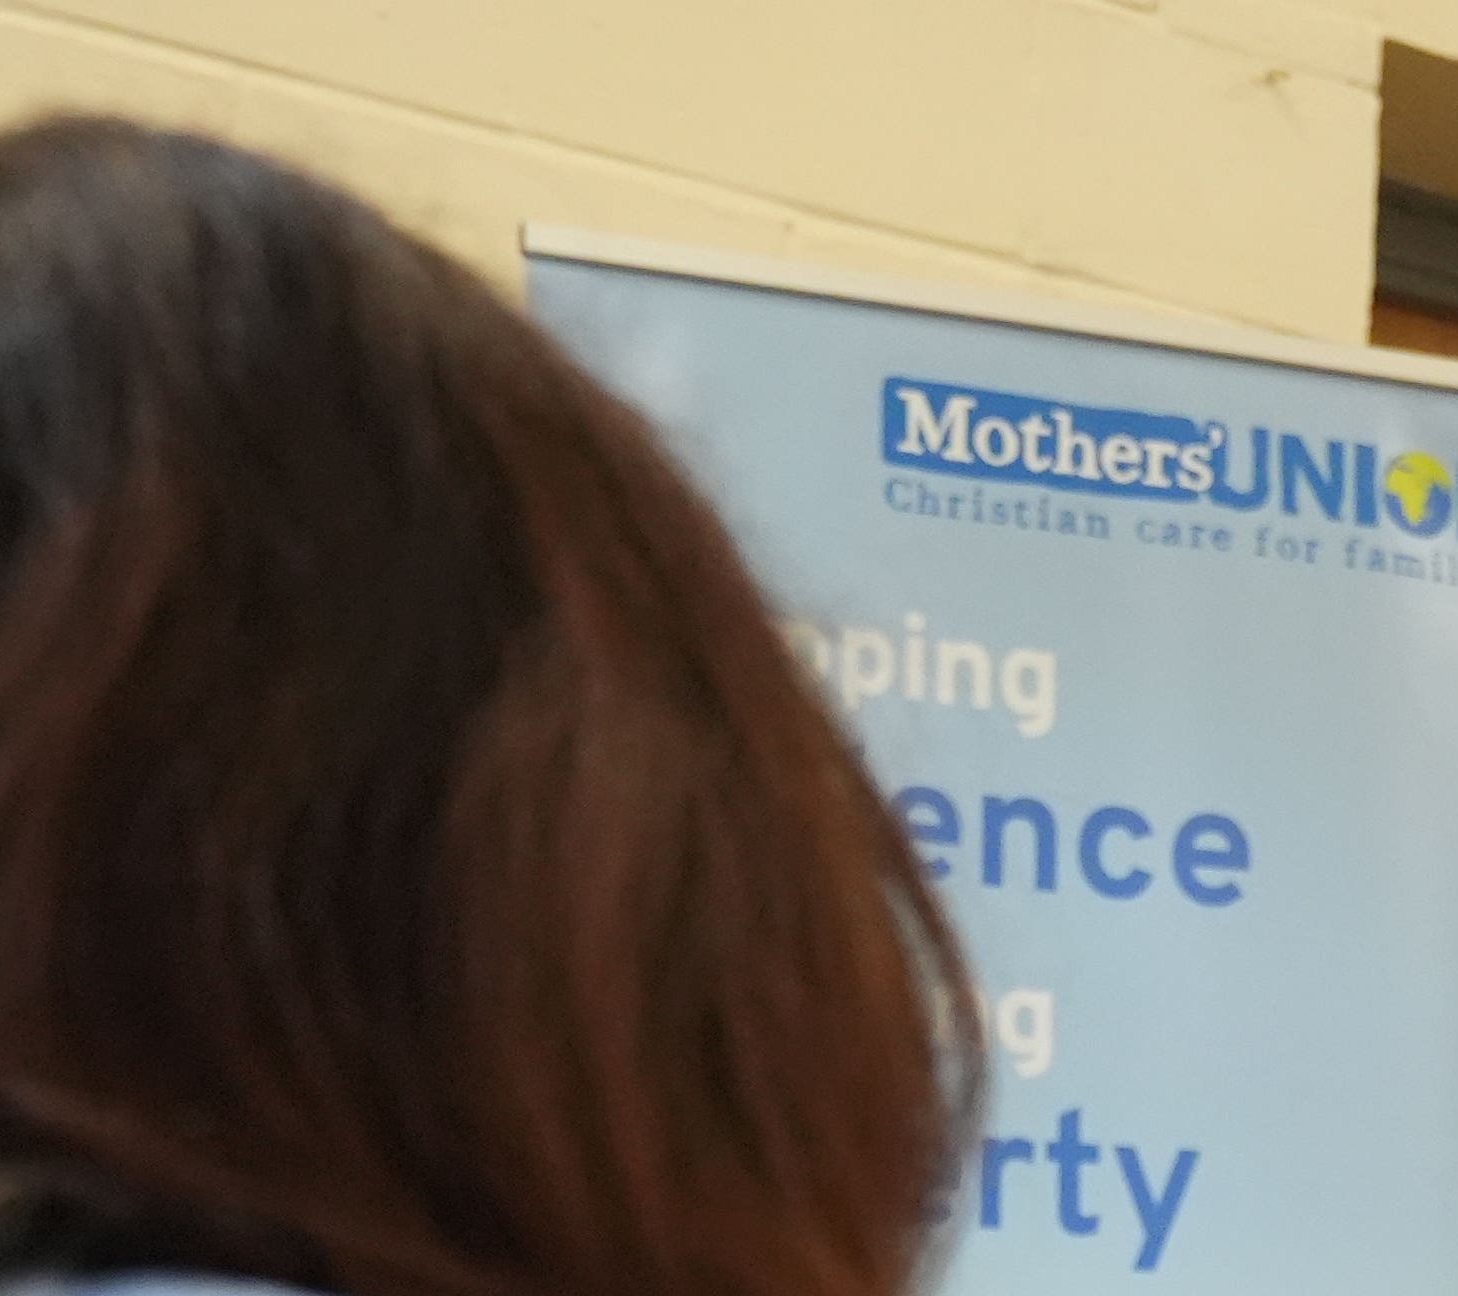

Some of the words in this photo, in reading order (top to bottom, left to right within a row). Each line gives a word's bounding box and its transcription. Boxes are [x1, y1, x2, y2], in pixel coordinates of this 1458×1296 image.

[885, 477, 1111, 540] Christian
[1136, 517, 1233, 552] care
[1253, 525, 1319, 565] for
[888, 785, 1252, 908] ence
